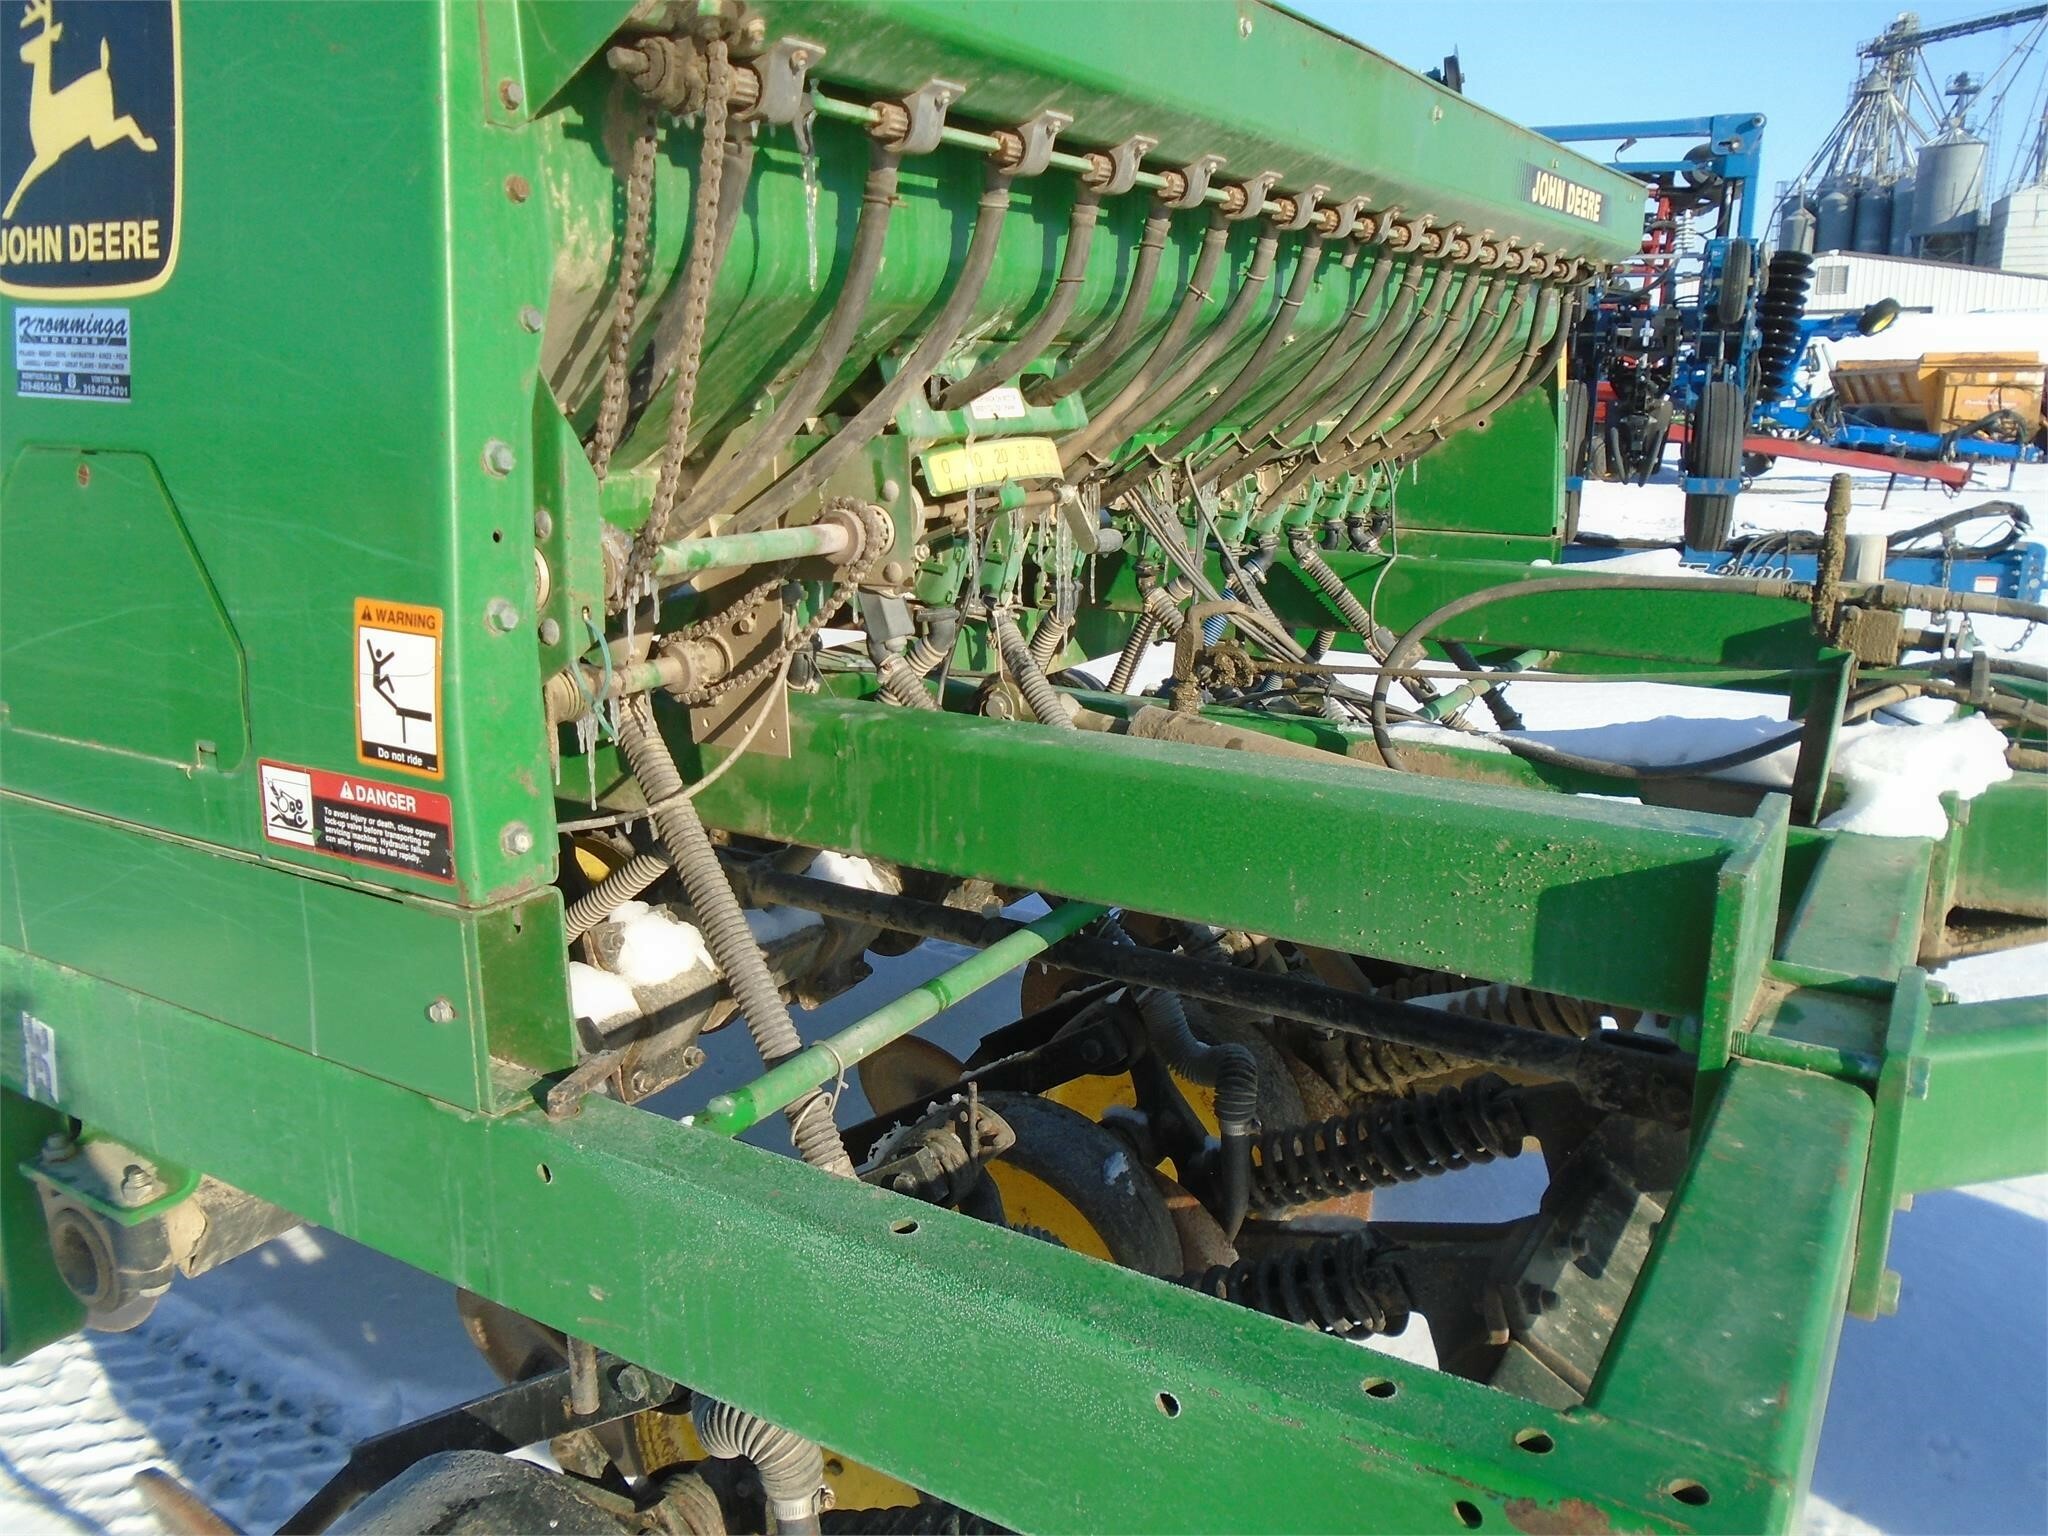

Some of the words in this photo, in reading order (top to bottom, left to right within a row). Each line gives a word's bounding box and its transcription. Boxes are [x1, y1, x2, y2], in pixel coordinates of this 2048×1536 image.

[1531, 170, 1567, 211] JOHN
[1566, 183, 1603, 222] DEERE
[0, 225, 62, 265] JOHN
[69, 219, 160, 263] DEERE
[19, 313, 128, 345] Kromminga
[40, 336, 98, 344] MOTORS
[82, 384, 128, 397] 319-472-4701
[375, 609, 436, 630] WARNING
[377, 747, 390, 759] Do
[392, 750, 406, 763] not
[407, 753, 423, 766] ride
[356, 785, 417, 814] DANGER
[324, 806, 333, 816] To
[333, 810, 349, 820] avoid
[368, 818, 376, 826] or
[376, 818, 397, 831] death,
[398, 823, 414, 834] close
[415, 828, 437, 840] opener
[324, 815, 346, 829] lock-up
[347, 821, 362, 832] valve
[363, 824, 384, 836] before
[385, 828, 422, 847] transporting
[422, 838, 430, 847] or
[325, 826, 351, 839] servicing
[380, 837, 410, 851] Hydraulic
[326, 835, 336, 843] can
[354, 841, 379, 854] openers
[379, 846, 387, 856] to
